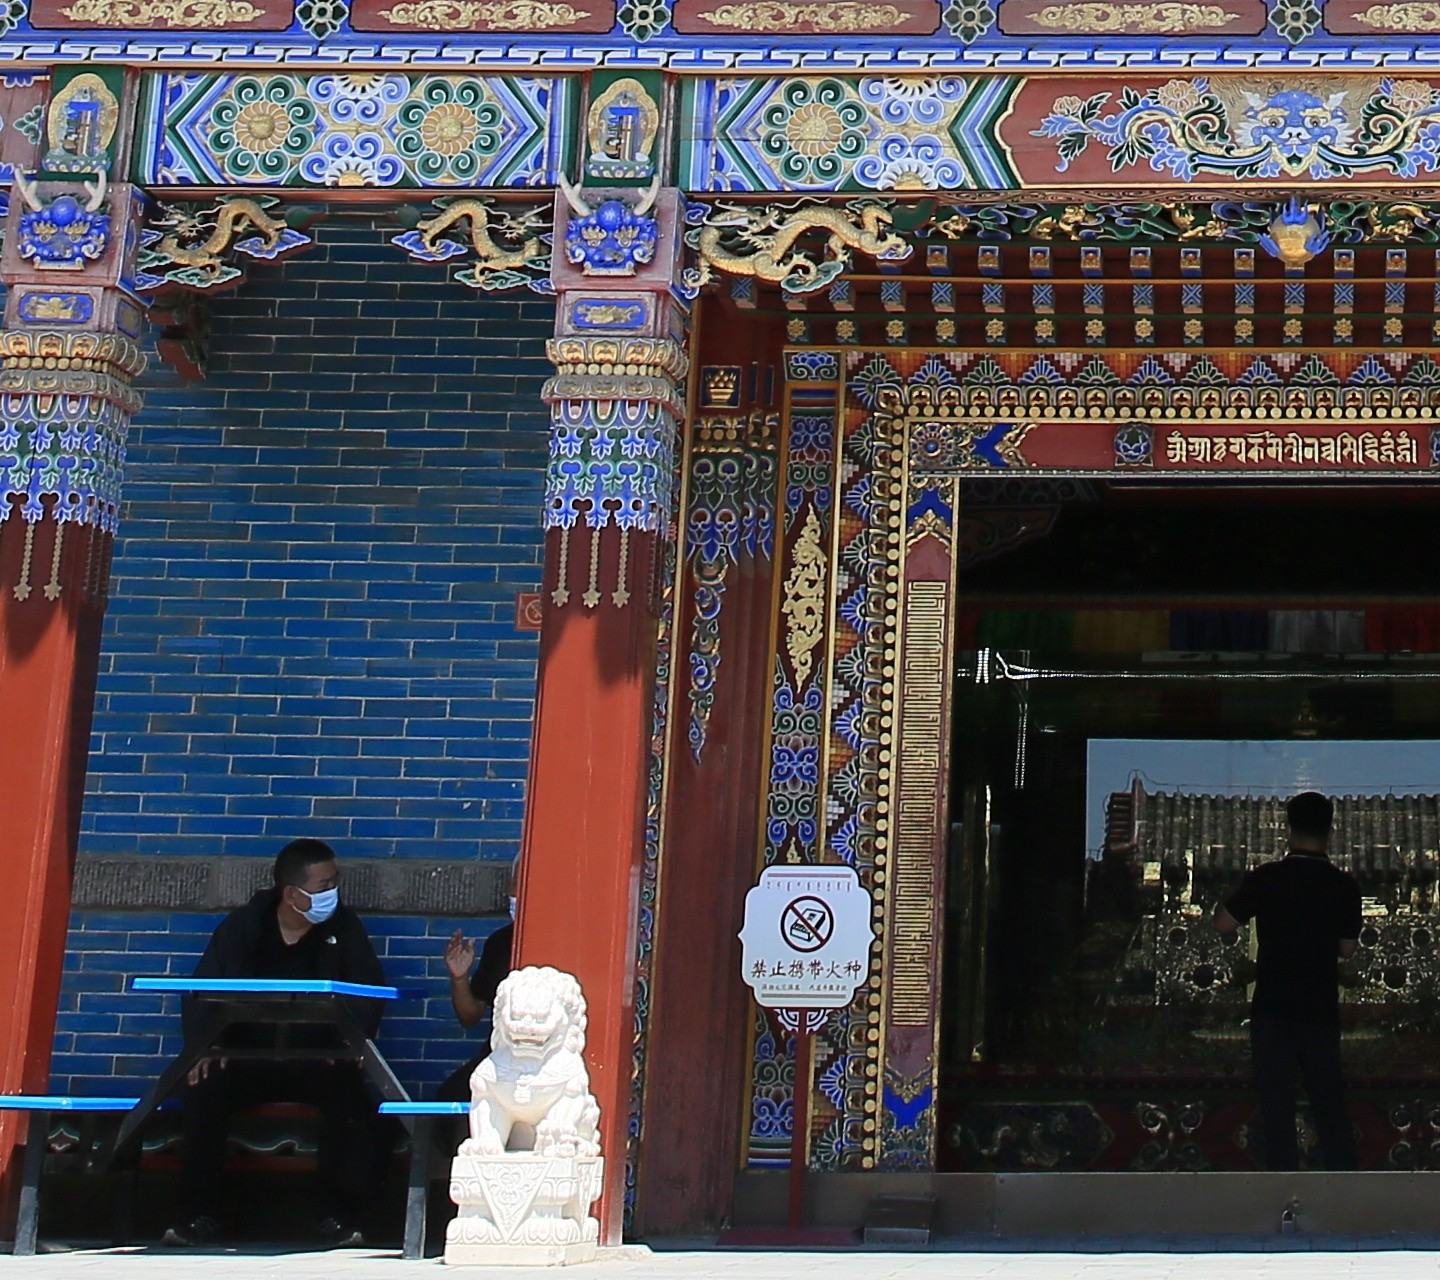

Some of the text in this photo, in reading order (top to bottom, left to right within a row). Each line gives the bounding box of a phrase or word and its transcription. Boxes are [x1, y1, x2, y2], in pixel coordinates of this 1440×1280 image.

[750, 958, 862, 981] 禁止携带火种
